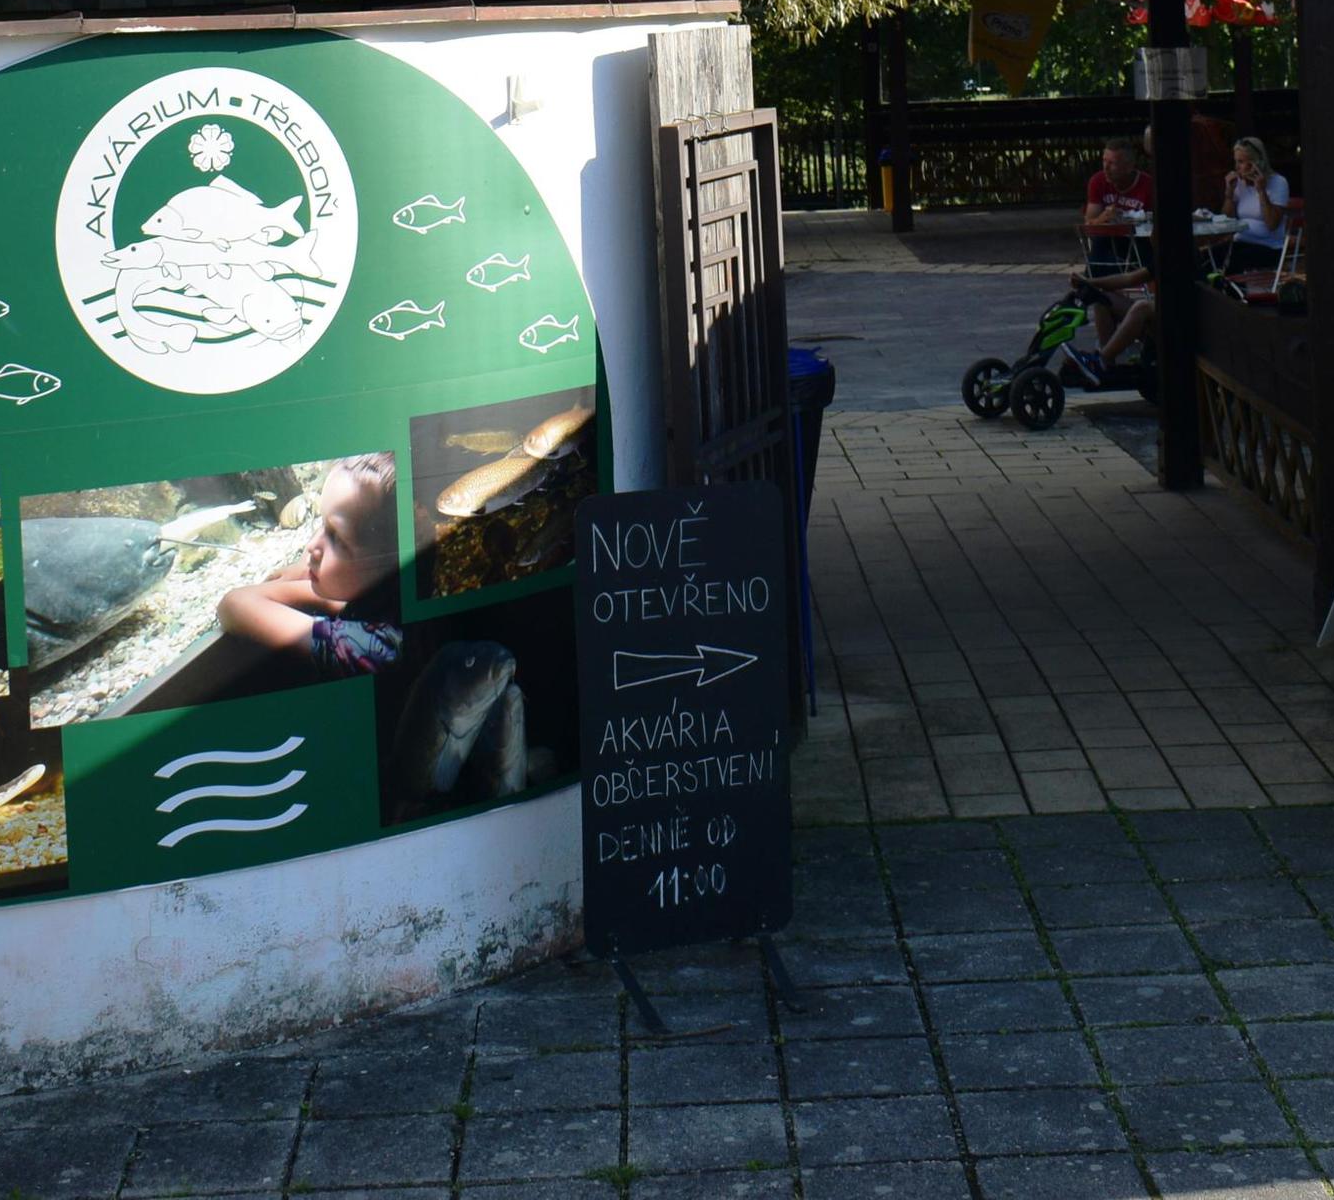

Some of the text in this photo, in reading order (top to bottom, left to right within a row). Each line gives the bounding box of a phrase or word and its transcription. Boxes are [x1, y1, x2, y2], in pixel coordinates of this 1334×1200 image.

[85, 86, 340, 239] AKVÁRIUM TŘEBOŇ
[591, 501, 710, 574] NOVĚ
[593, 572, 770, 623] OTEVŘENO
[599, 696, 734, 755] AKVÁRIA
[593, 729, 779, 808] OBČERSTVENÍ
[598, 805, 693, 864] DENNĚ
[647, 863, 727, 909] 11:00
